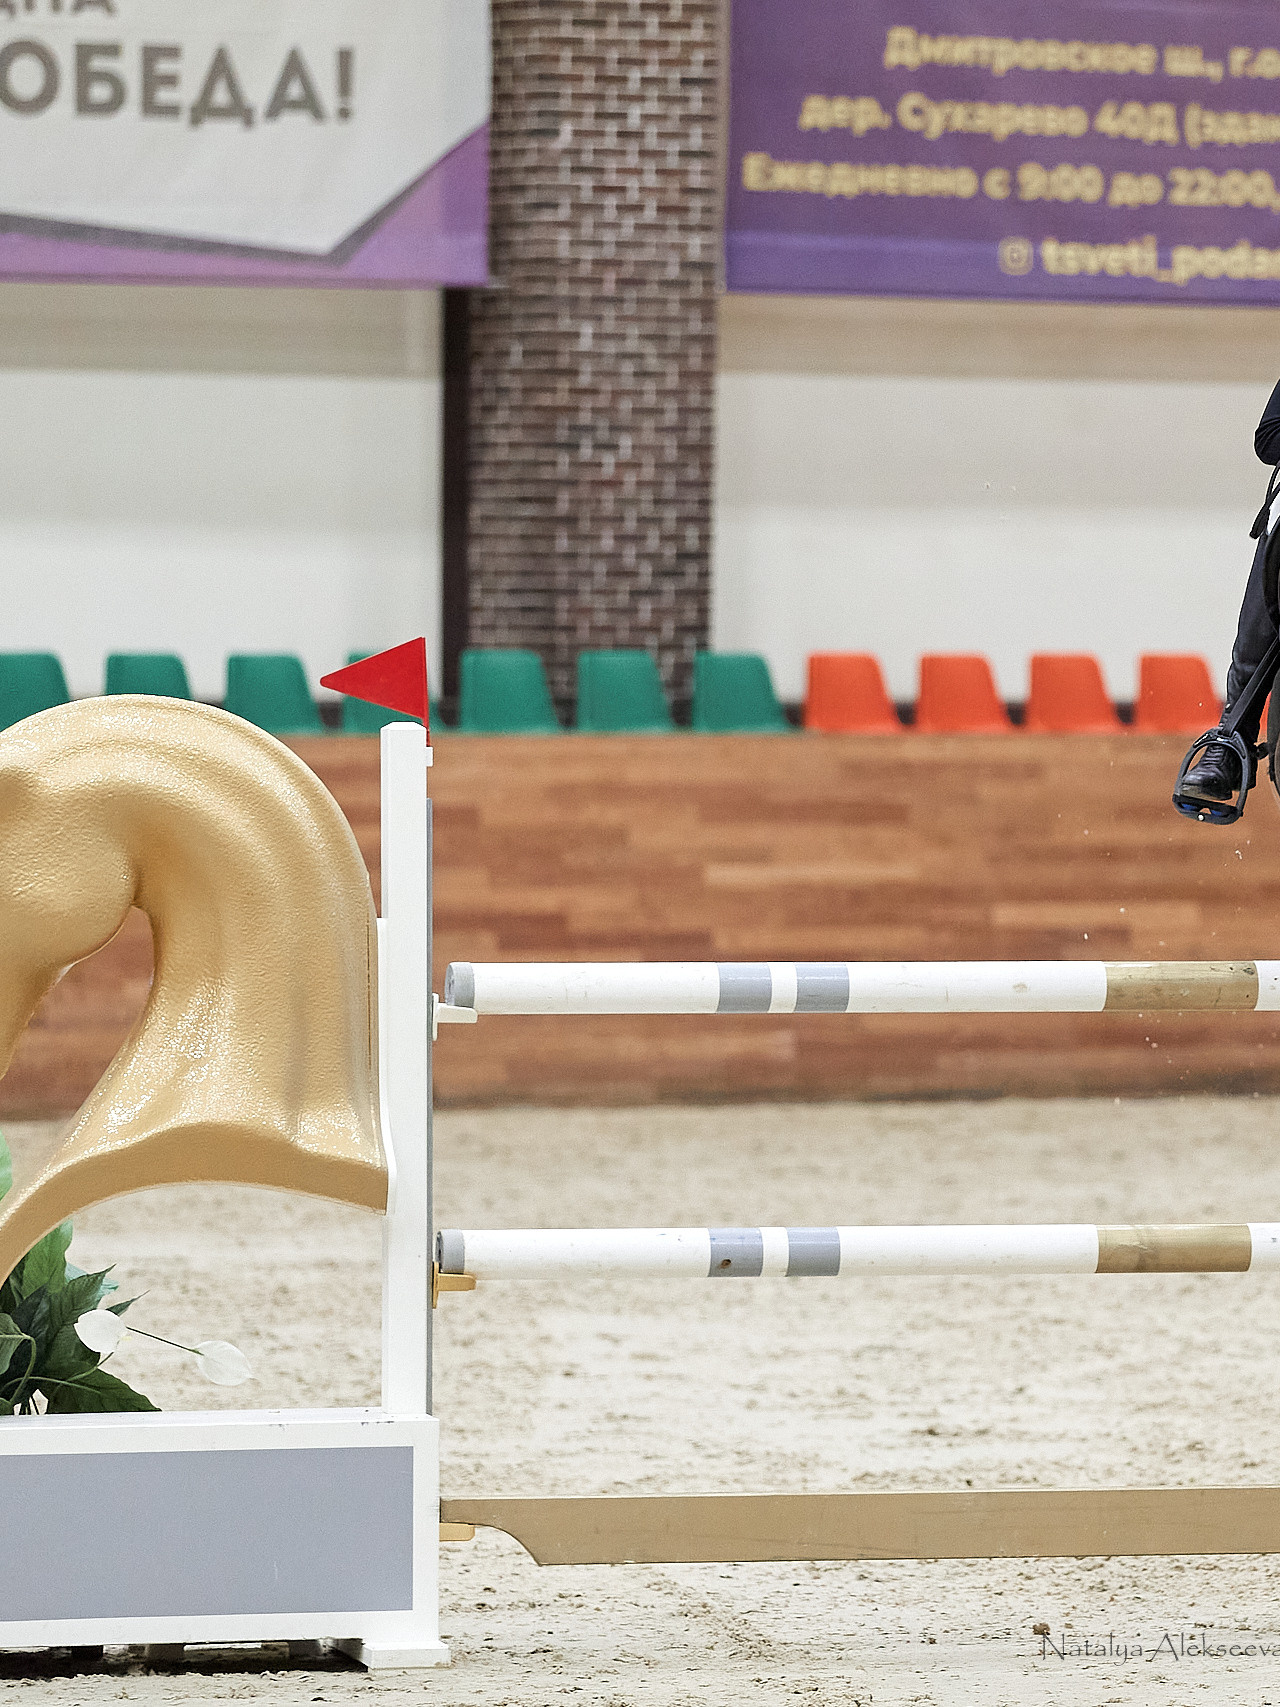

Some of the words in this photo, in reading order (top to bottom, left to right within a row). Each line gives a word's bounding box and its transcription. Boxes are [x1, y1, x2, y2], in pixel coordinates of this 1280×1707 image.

[897, 93, 1088, 140] Сухарево
[984, 168, 1011, 199] с
[1018, 163, 1103, 202] 9:00
[1109, 173, 1163, 207] до
